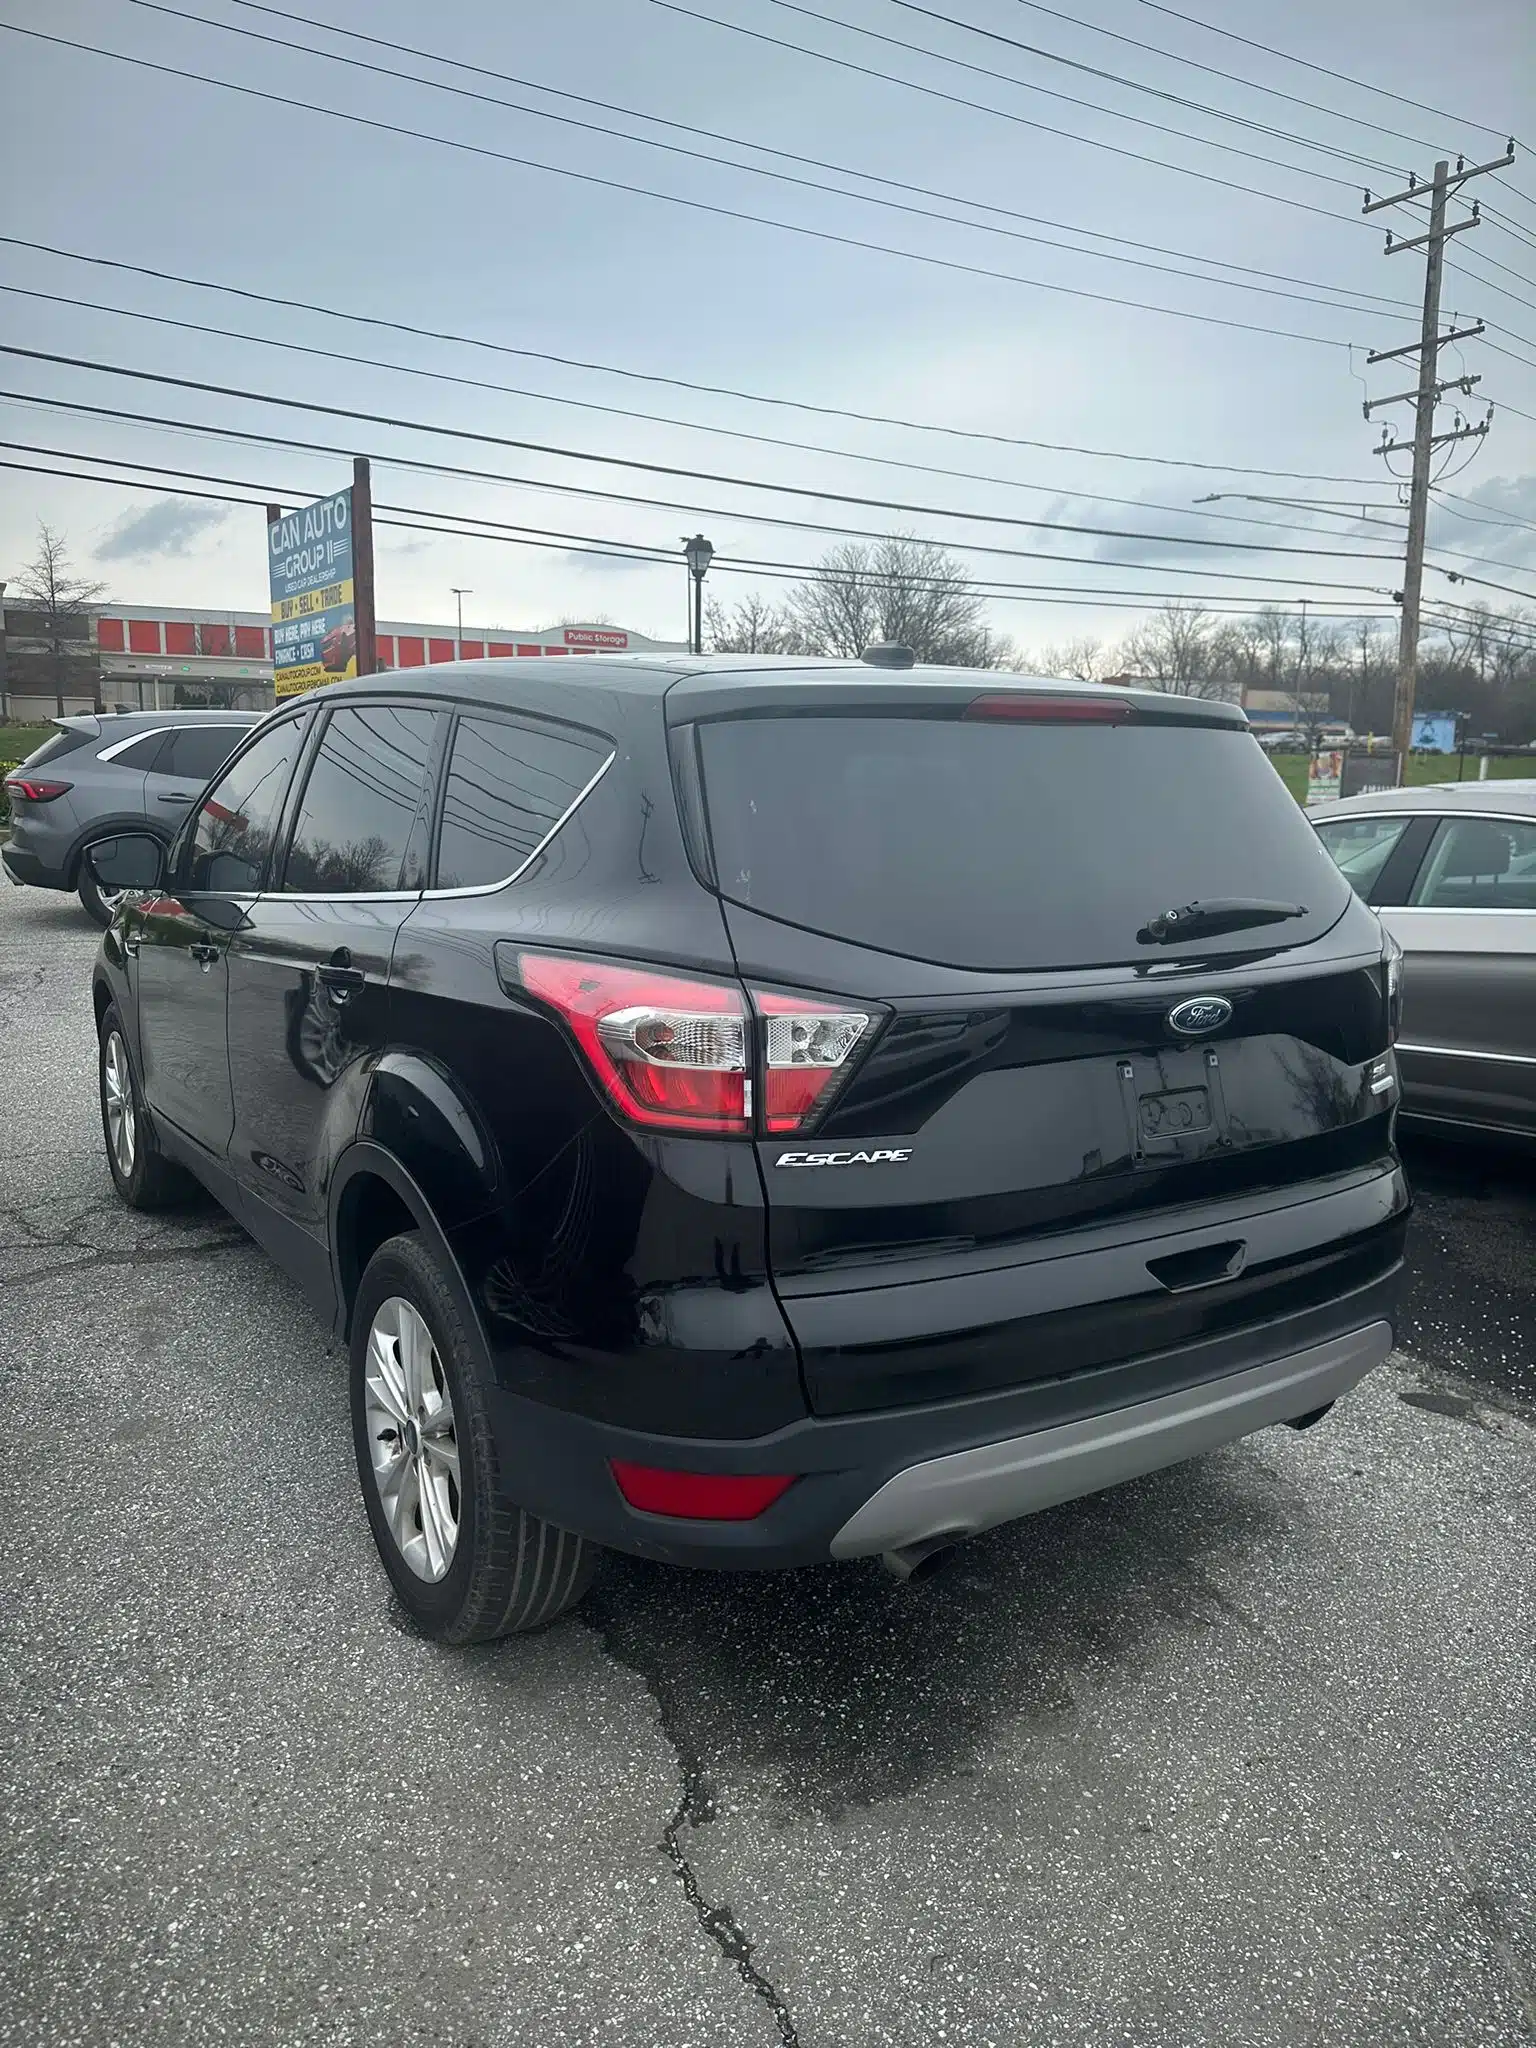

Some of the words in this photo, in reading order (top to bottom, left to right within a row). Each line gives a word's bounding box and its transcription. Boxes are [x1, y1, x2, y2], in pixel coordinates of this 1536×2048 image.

[272, 516, 300, 555] CAN
[304, 496, 347, 544] AUTO
[285, 544, 324, 578] GROUP
[285, 580, 297, 594] USED
[307, 567, 337, 587] DEALERSHIP
[281, 599, 293, 620] BUY
[299, 593, 314, 615] SELL
[320, 583, 342, 609] TRADE
[274, 628, 285, 645] BUY
[299, 621, 311, 639] PAY
[311, 617, 326, 635] HERE
[568, 632, 593, 641] Public
[595, 634, 625, 645] Storage
[275, 646, 296, 665] FINANCE
[300, 642, 314, 660] CASH
[1186, 1005, 1221, 1026] Ford
[775, 1148, 913, 1167] ESCAPE
